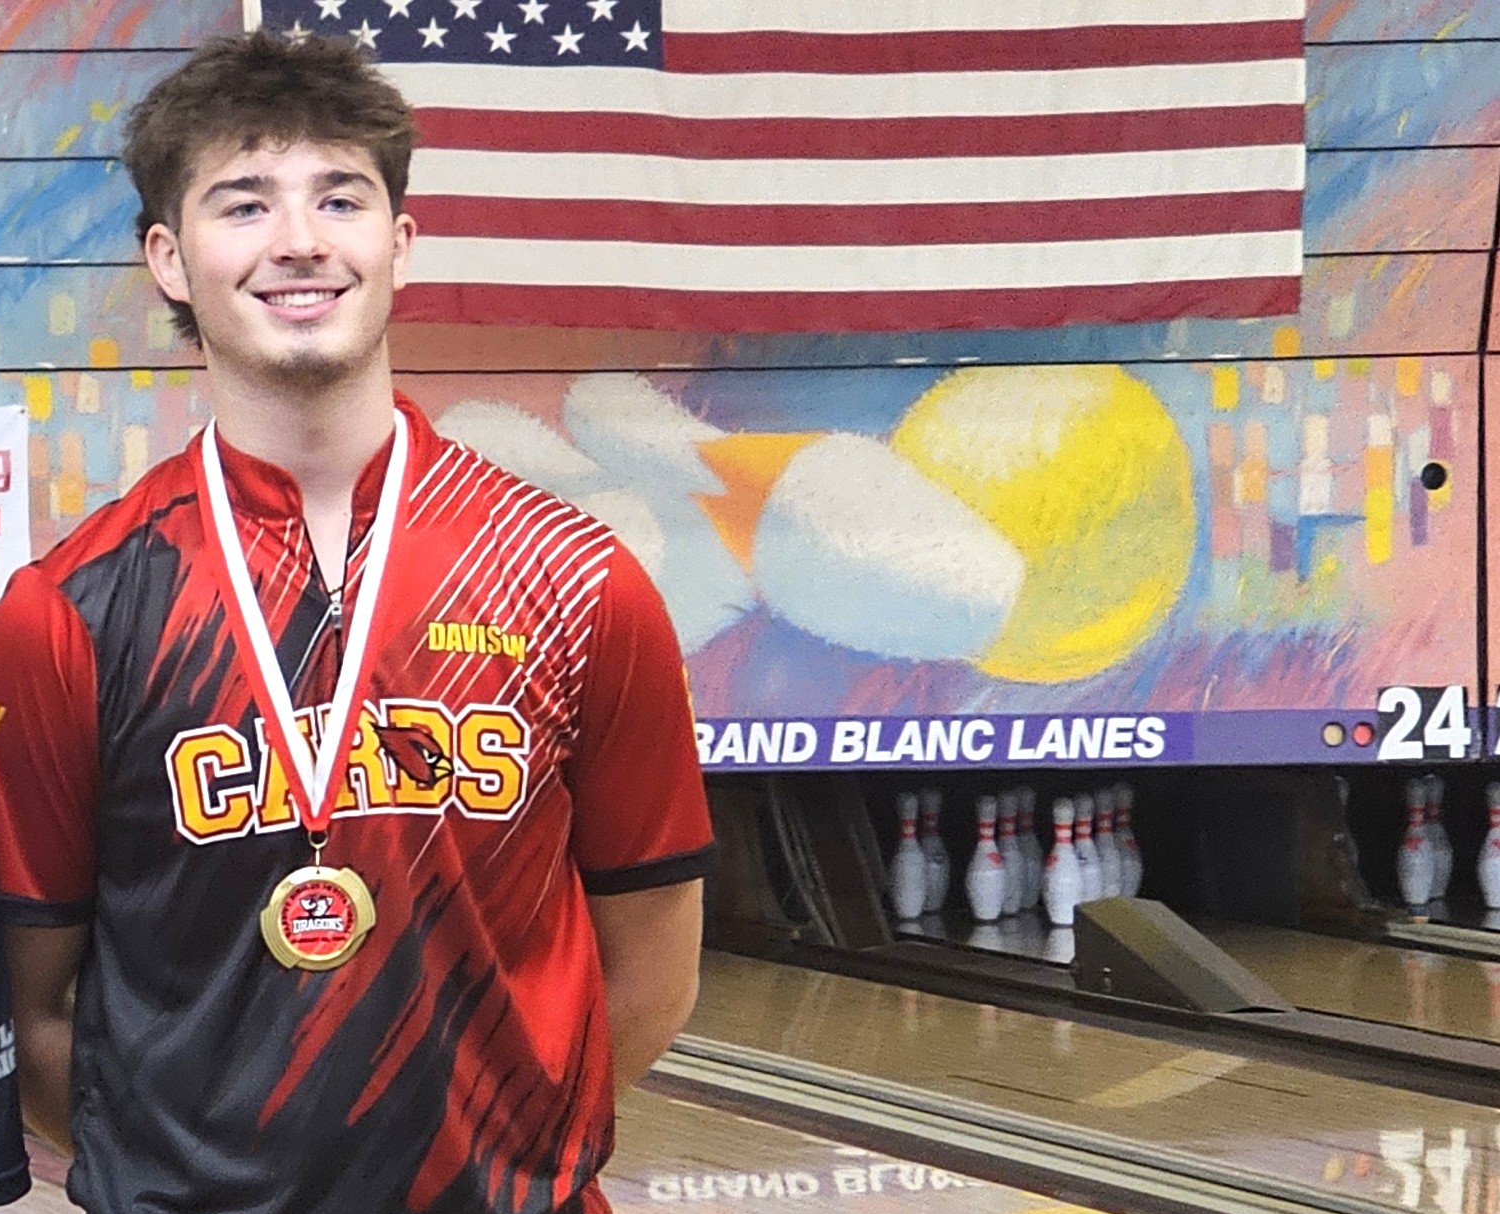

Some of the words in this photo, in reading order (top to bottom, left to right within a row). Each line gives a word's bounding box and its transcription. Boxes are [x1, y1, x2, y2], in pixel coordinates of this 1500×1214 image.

[695, 721, 818, 763] RAND
[830, 719, 995, 763] BLANC
[1007, 716, 1167, 760] LANES
[1377, 685, 1472, 760] 24
[292, 916, 345, 934] DRAGONS
